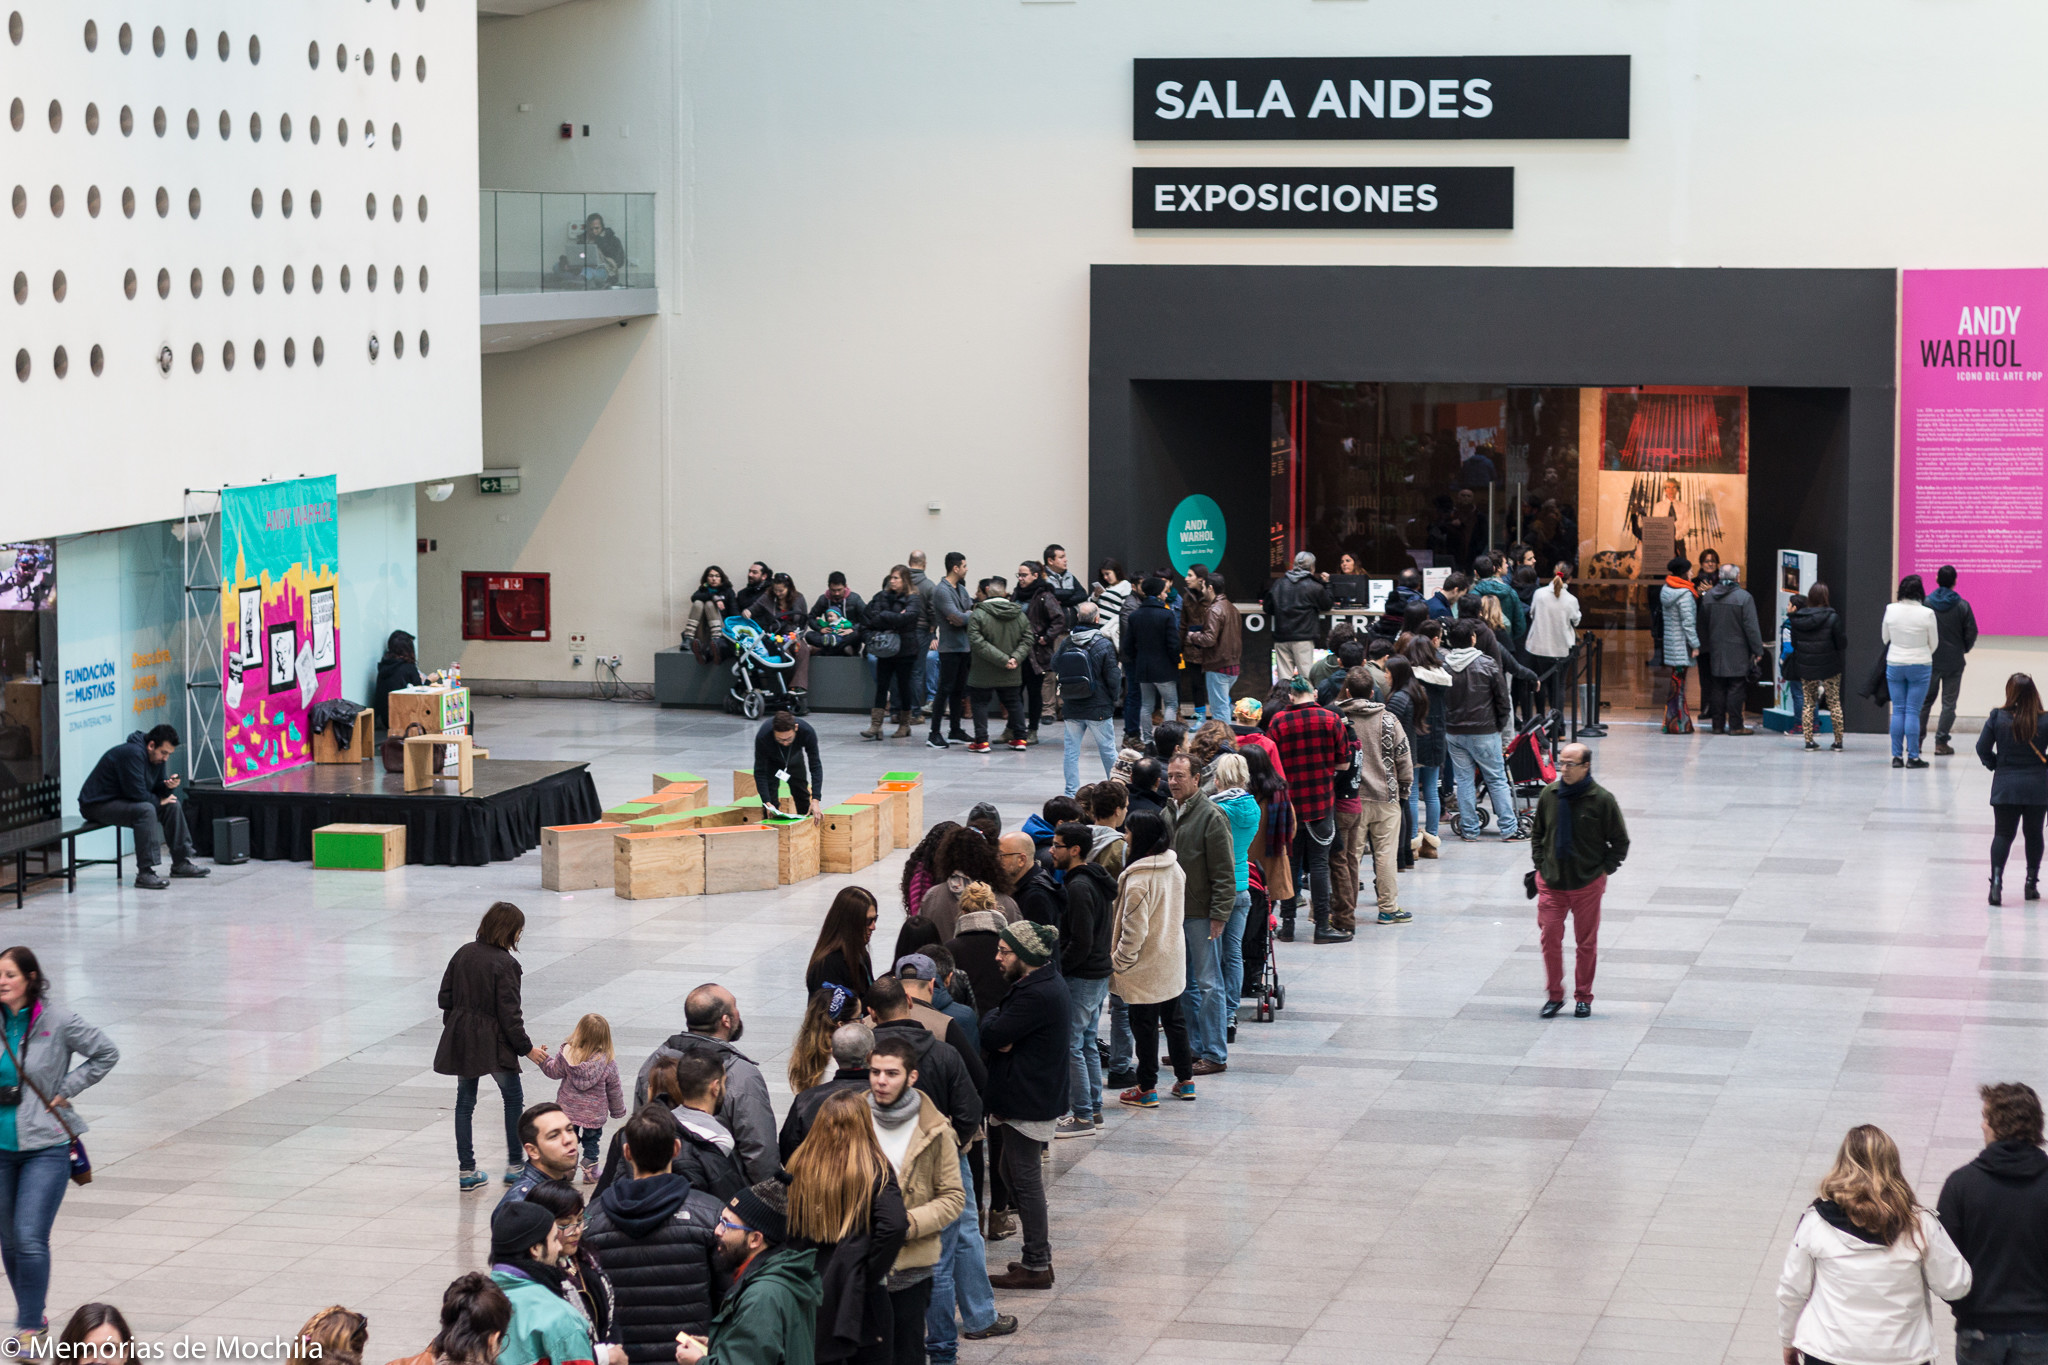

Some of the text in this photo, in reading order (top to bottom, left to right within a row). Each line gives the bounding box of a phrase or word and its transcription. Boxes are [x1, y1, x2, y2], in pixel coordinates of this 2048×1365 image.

[1154, 78, 1494, 120] SALA ANDES
[1153, 183, 1439, 213] EXPOSICIONES
[1957, 305, 2022, 335] ANDY
[1920, 339, 2022, 368] WARHOL
[1956, 371, 2043, 382] ICONO DEL ARTE POP
[265, 502, 333, 533] ANDY WARHOL
[1184, 519, 1208, 531] ANDY
[1179, 530, 1215, 543] WARHOL
[65, 658, 115, 686] FUNDACIÓN
[75, 681, 116, 704] MUSTAKIS
